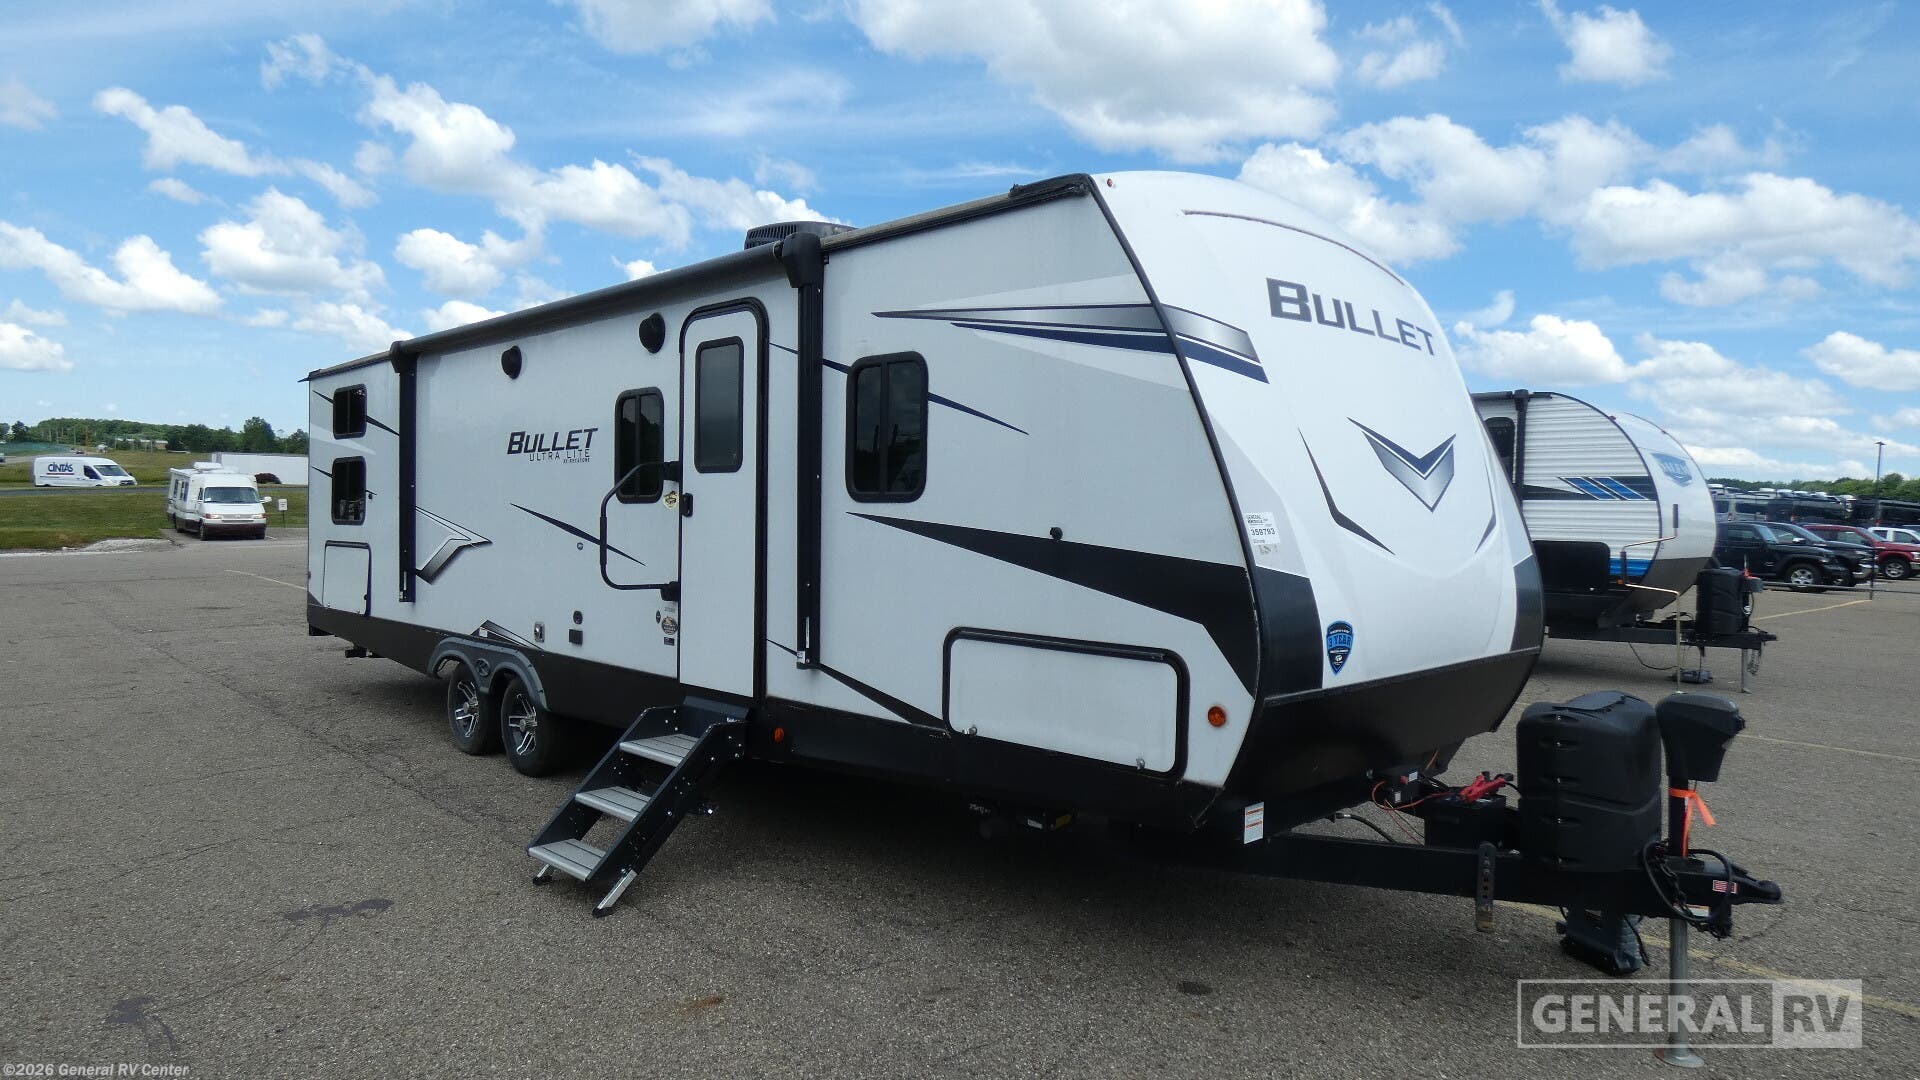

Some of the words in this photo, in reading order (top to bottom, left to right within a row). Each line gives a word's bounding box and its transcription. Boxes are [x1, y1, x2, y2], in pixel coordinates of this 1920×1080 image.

[1266, 277, 1435, 356] BULLET
[506, 427, 599, 455] BULLET
[529, 451, 560, 462] ULTRA
[566, 448, 590, 459] LITE
[47, 461, 74, 473] CINTAS
